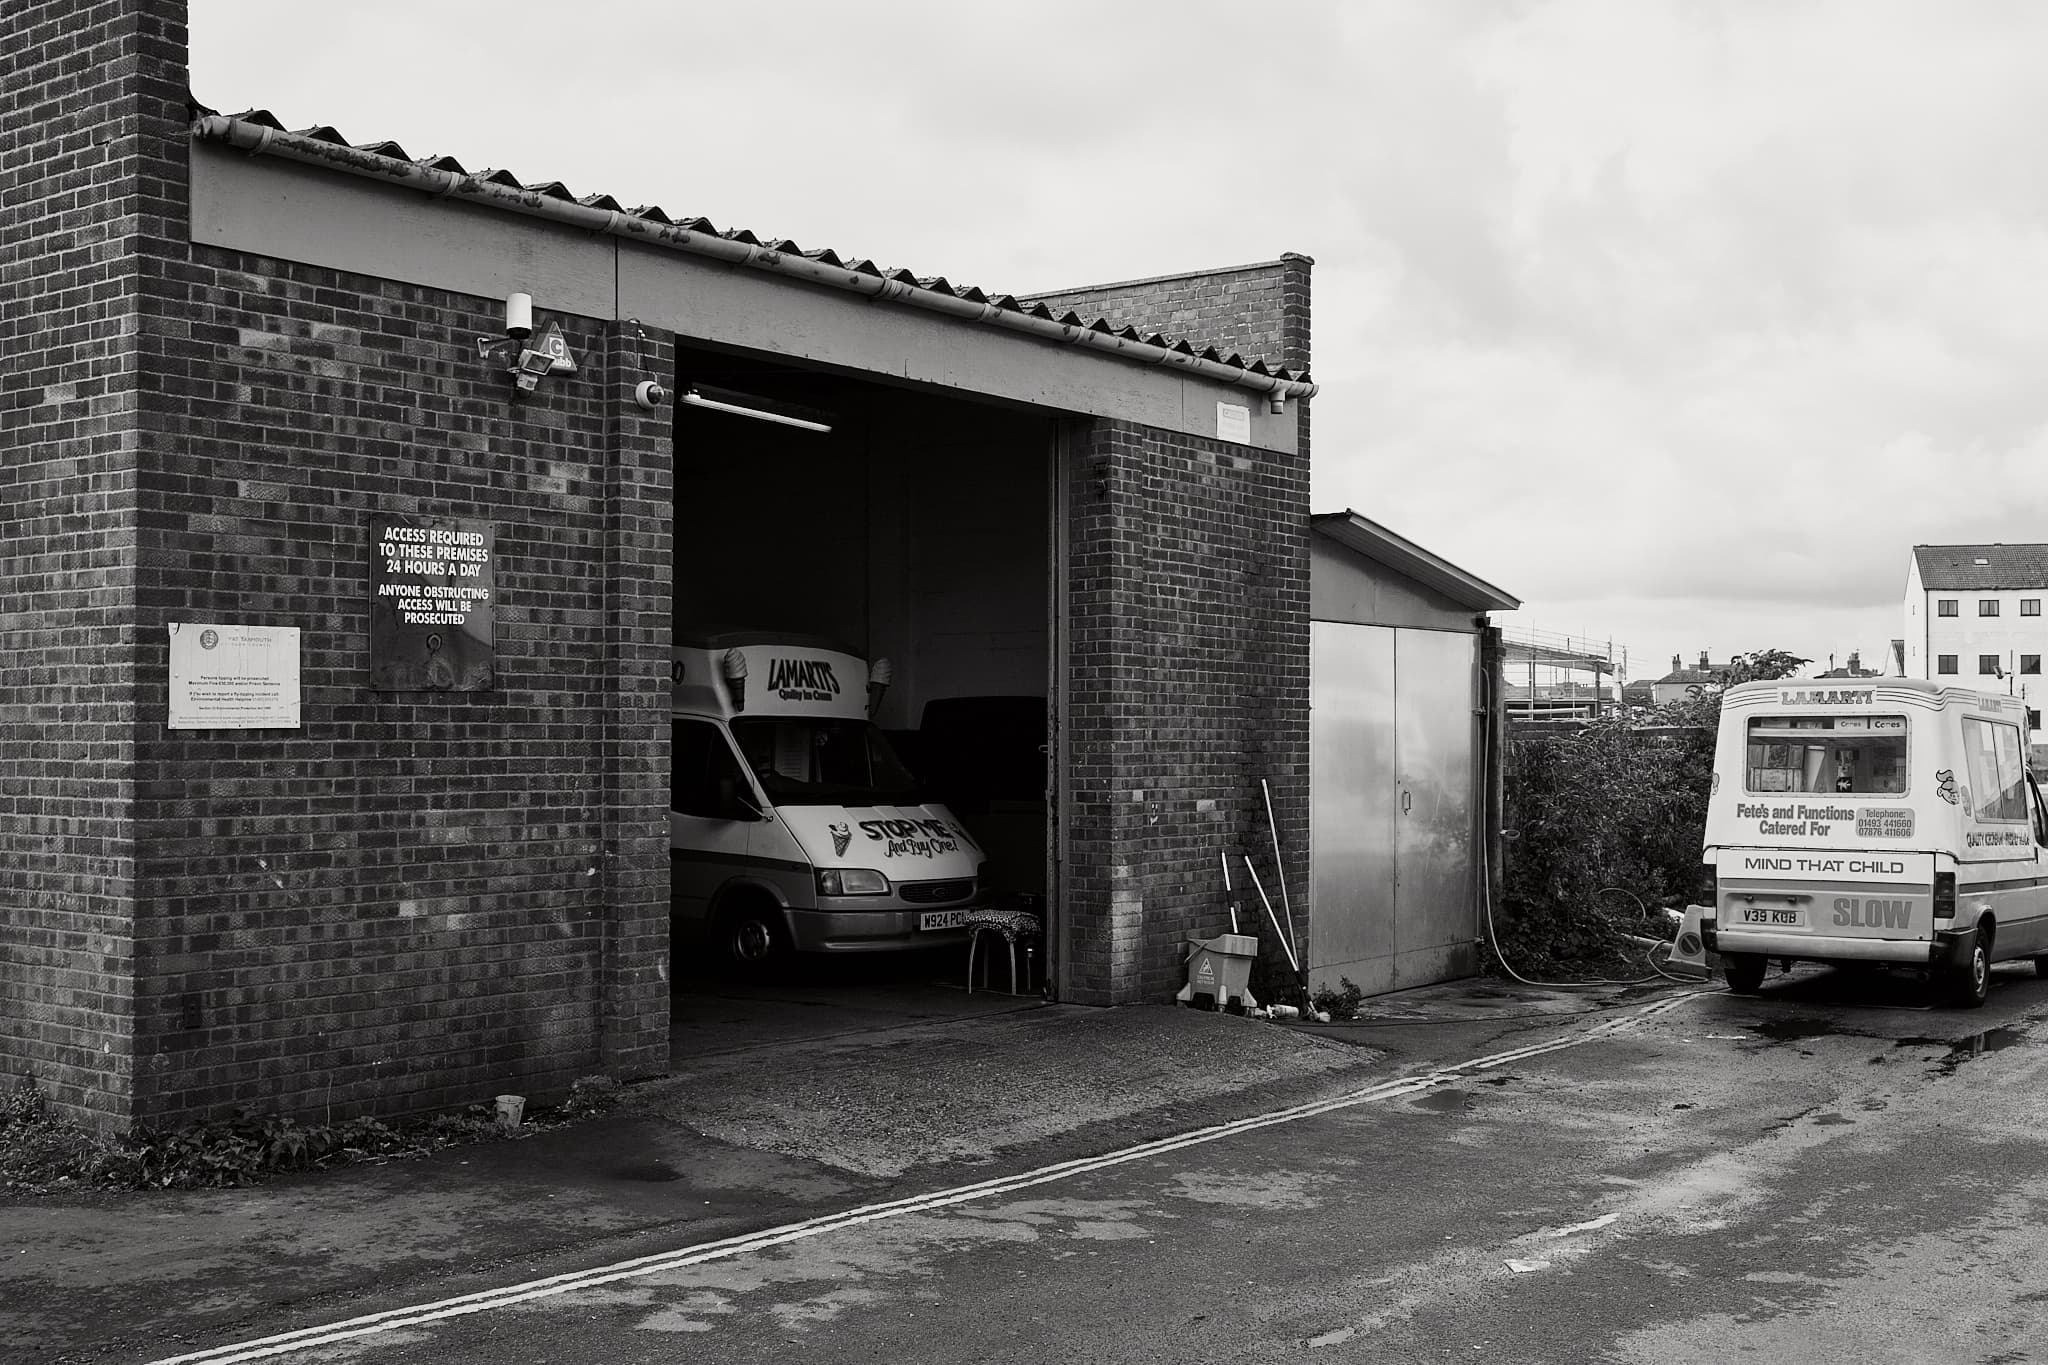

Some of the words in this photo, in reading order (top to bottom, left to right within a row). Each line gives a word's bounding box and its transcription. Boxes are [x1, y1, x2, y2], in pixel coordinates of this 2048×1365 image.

[384, 527, 426, 542] ACCESS
[429, 529, 484, 546] REQUIRED
[379, 542, 396, 556] TO
[398, 543, 433, 559] THESE
[436, 546, 489, 562] PREMISES
[386, 559, 401, 573] 24
[404, 560, 445, 575] HOURS
[447, 562, 457, 576] A
[460, 563, 482, 577] DAY
[378, 584, 421, 597] ANYONE
[423, 585, 489, 600] OBSTRUCTING
[397, 598, 433, 611] ACCESS
[435, 599, 458, 612] WILL
[460, 601, 472, 612] BE
[404, 612, 465, 625] PROSECUTED
[1781, 690, 1873, 705] LAMARTI
[1736, 803, 1770, 819] Fete's
[1772, 804, 1794, 820] and
[1797, 804, 1855, 821] Functions
[1865, 809, 1906, 819] Telephone:
[858, 818, 918, 841] STOP
[908, 818, 956, 839] ME
[1759, 820, 1806, 836] Catered
[1810, 821, 1831, 836] For
[1858, 819, 1882, 828] 01493
[883, 839, 909, 858] And
[905, 838, 933, 859] Buy
[1745, 857, 1792, 871] MIND
[1796, 859, 1844, 872] THAT
[1848, 861, 1904, 874] CHILD
[924, 913, 949, 928] W924
[1743, 909, 1767, 922] V39
[1832, 898, 1913, 929] SLOW
